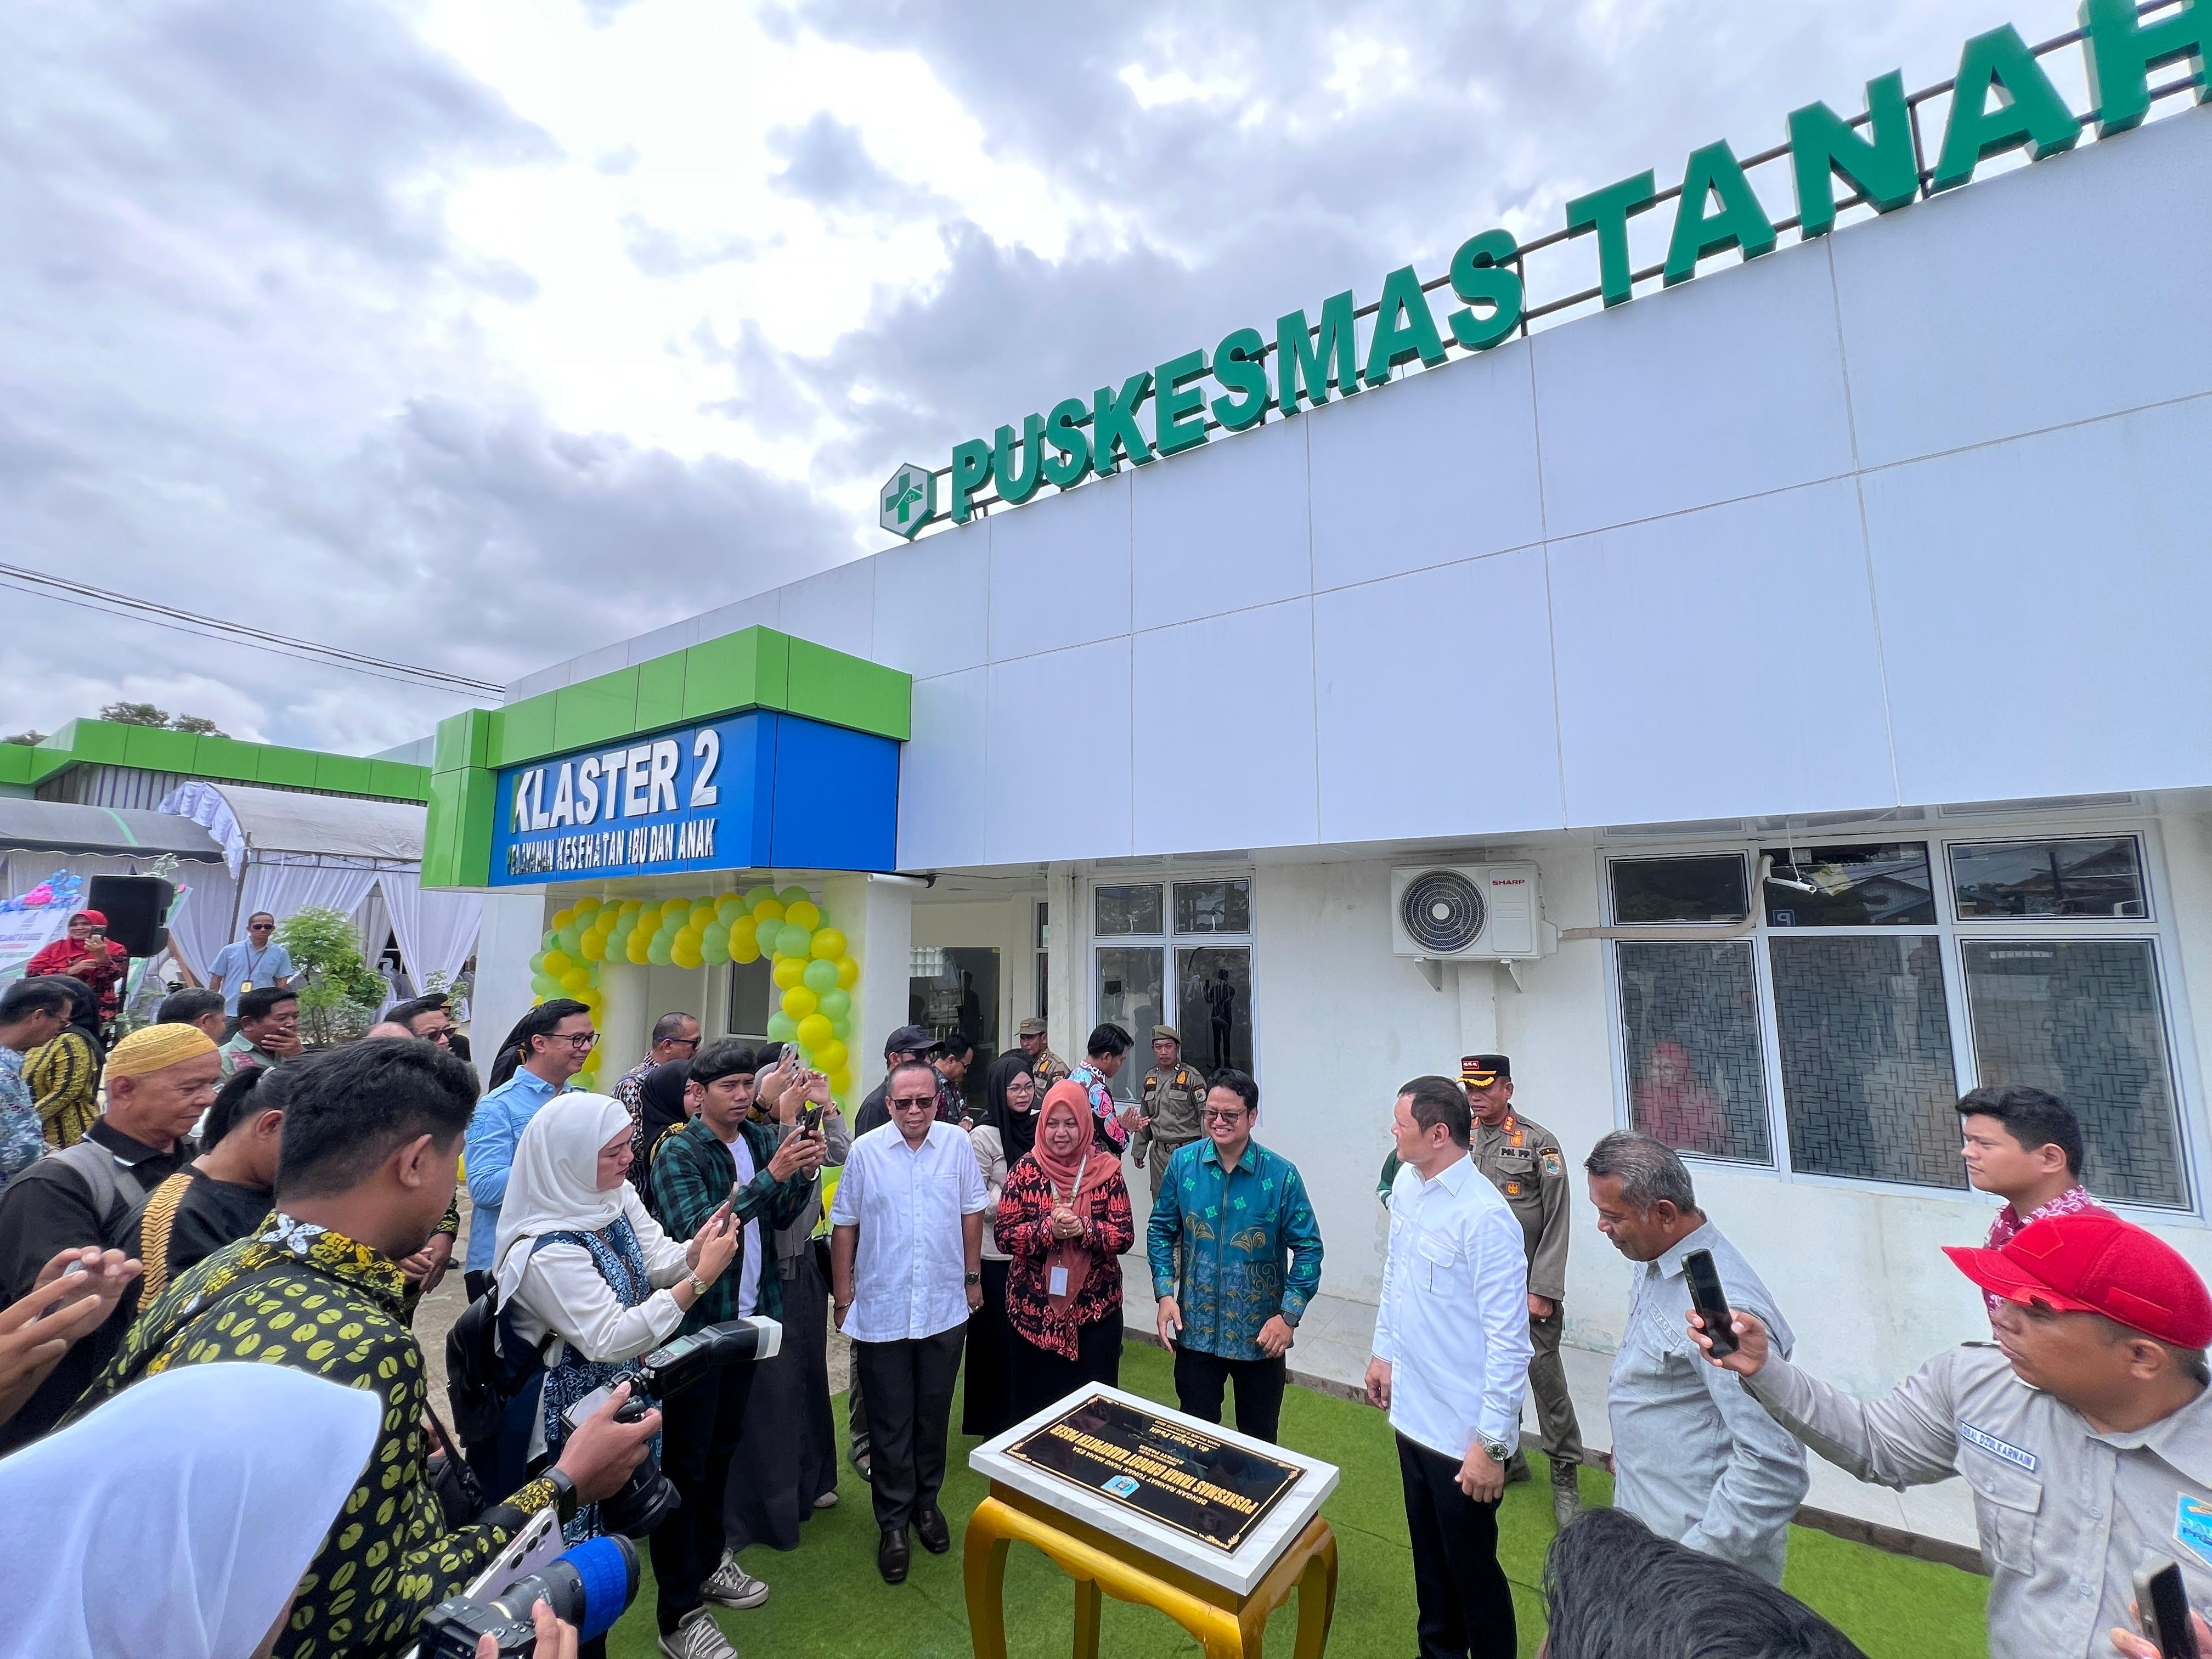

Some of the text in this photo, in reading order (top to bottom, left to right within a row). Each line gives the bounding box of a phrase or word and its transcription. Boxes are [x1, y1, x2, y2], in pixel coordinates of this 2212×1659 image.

[951, 0, 2212, 524] PUSKESMAS TANAH
[511, 729, 719, 833] KLASTER 2
[556, 830, 625, 871] KESEHATAN
[627, 826, 648, 865] IBU
[649, 823, 675, 862] DAN
[678, 818, 719, 860] ANAK
[1049, 1424, 1259, 1514] PUSKESMAS TANAH GROGOT KABUPATEN PASER
[1072, 1446, 1207, 1505] DENGAN RAHMAT TUHAN YANG MAHA ESA
